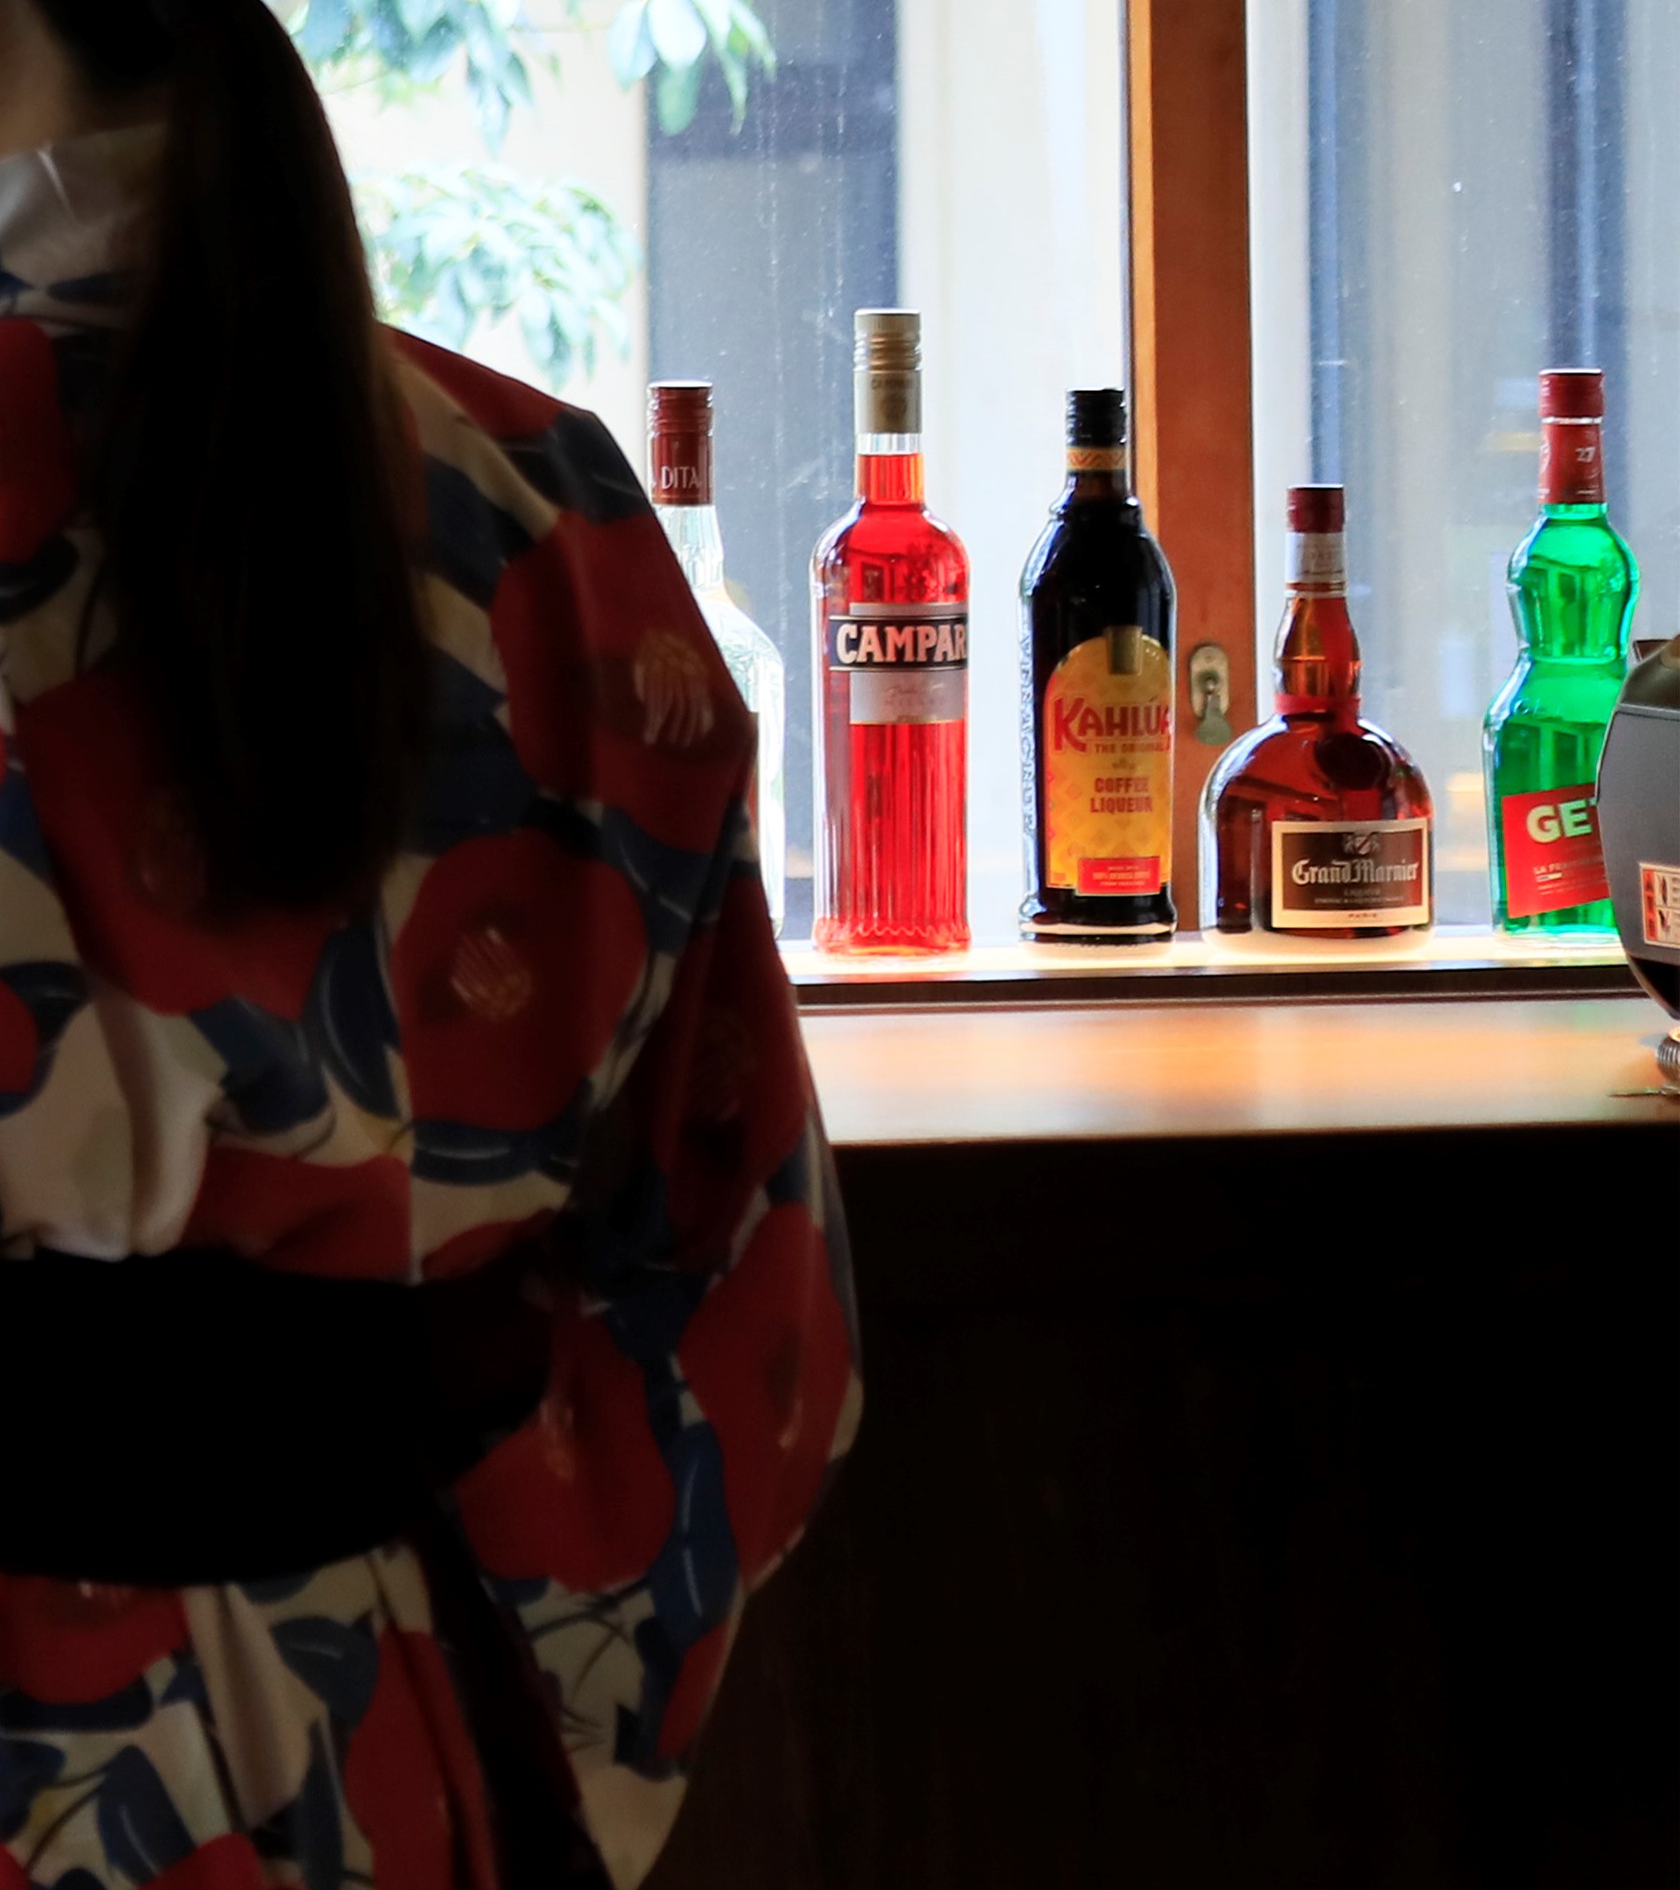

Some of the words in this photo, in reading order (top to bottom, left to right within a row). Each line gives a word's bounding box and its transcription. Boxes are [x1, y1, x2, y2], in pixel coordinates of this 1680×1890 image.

[661, 465, 700, 490] DITA
[1095, 777, 1150, 793] COFFEE
[1090, 797, 1153, 814] LIQUEUR
[1526, 798, 1597, 843] GE
[1291, 859, 1352, 885] Grand
[1352, 858, 1419, 884] Marnier
